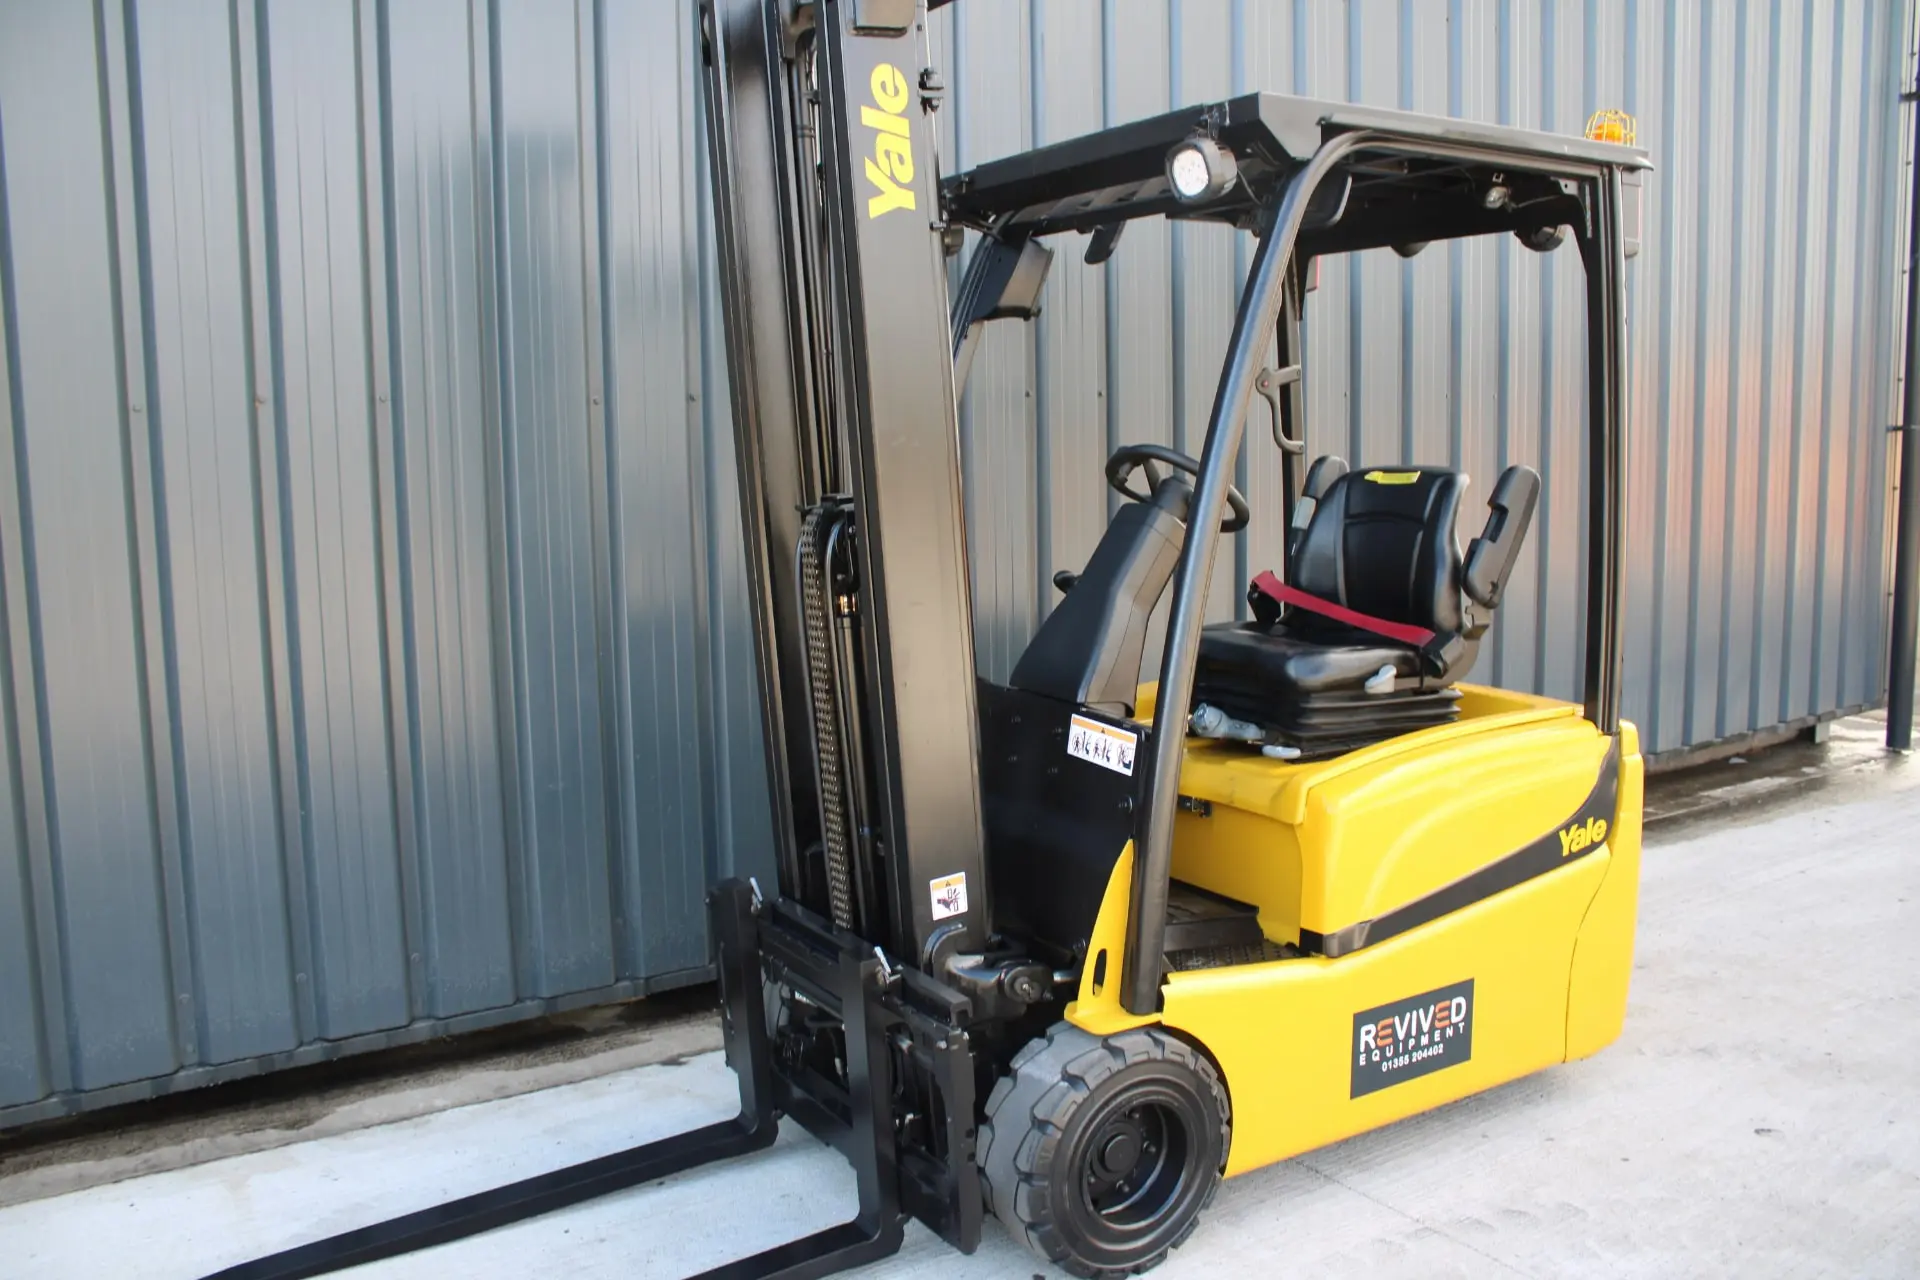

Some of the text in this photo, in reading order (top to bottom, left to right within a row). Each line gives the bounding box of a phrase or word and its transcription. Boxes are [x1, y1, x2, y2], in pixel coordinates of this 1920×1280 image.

[861, 63, 915, 219] Yale
[1559, 816, 1607, 857] Yale
[1359, 1022, 1465, 1066] EQUIPMENT
[1360, 996, 1467, 1053] REVIVED
[1411, 1043, 1444, 1062] 204402
